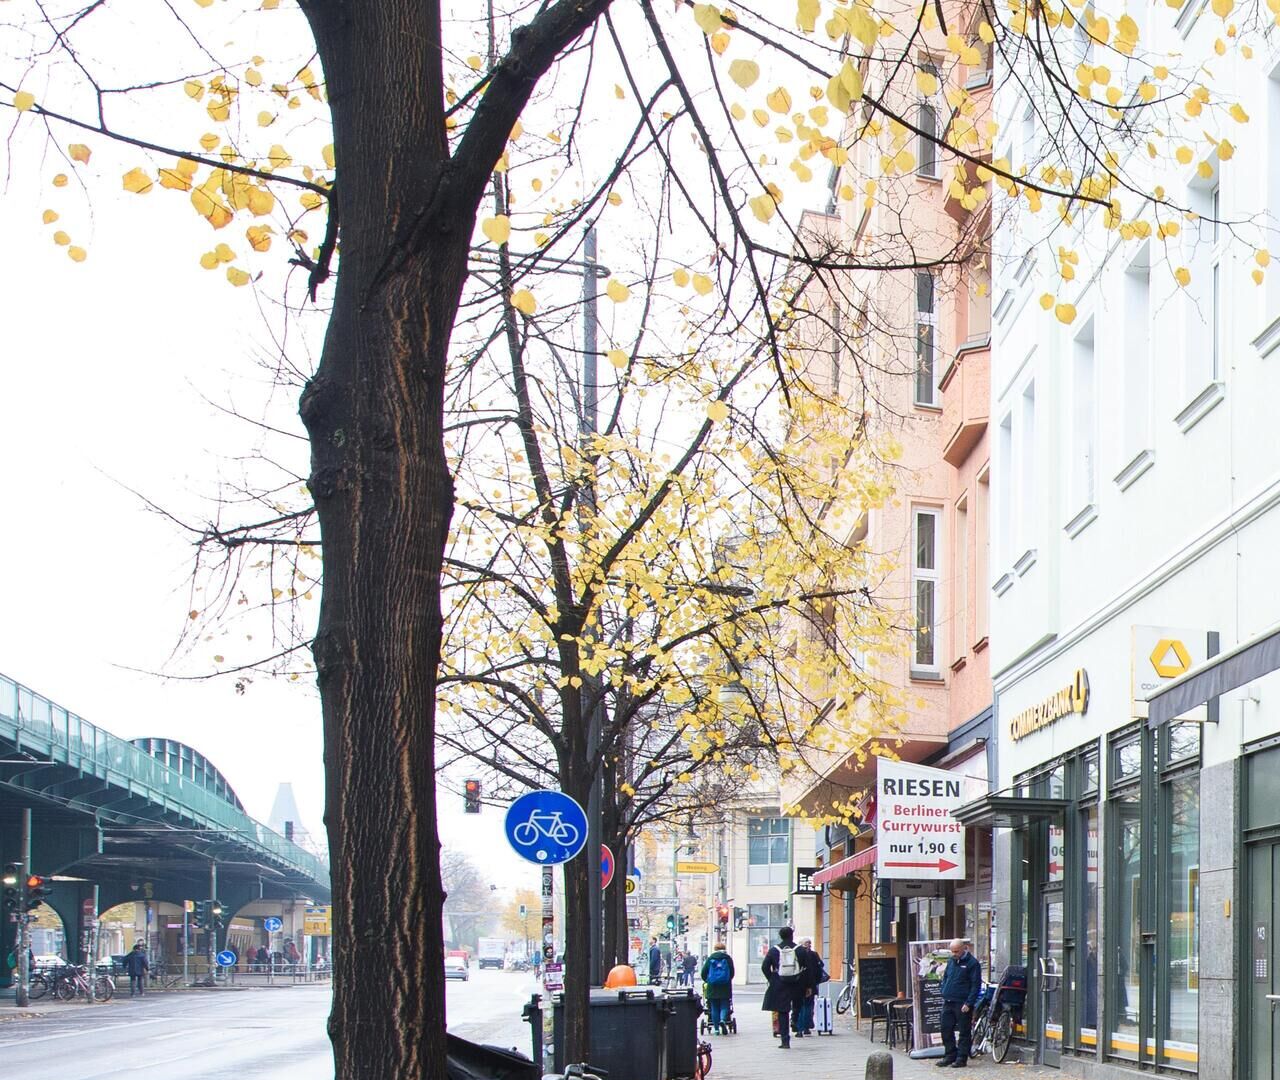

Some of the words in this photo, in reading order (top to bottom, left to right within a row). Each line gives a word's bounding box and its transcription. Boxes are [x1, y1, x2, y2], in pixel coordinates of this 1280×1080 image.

[1009, 684, 1074, 743] COMMERZBANK
[883, 778, 960, 798] RIESEN
[893, 804, 949, 817] Berliner
[882, 820, 961, 835] Currywurst
[890, 844, 913, 853] nur
[918, 843, 945, 855] 1,90
[950, 843, 958, 854] €
[799, 873, 807, 891] ZEIT
